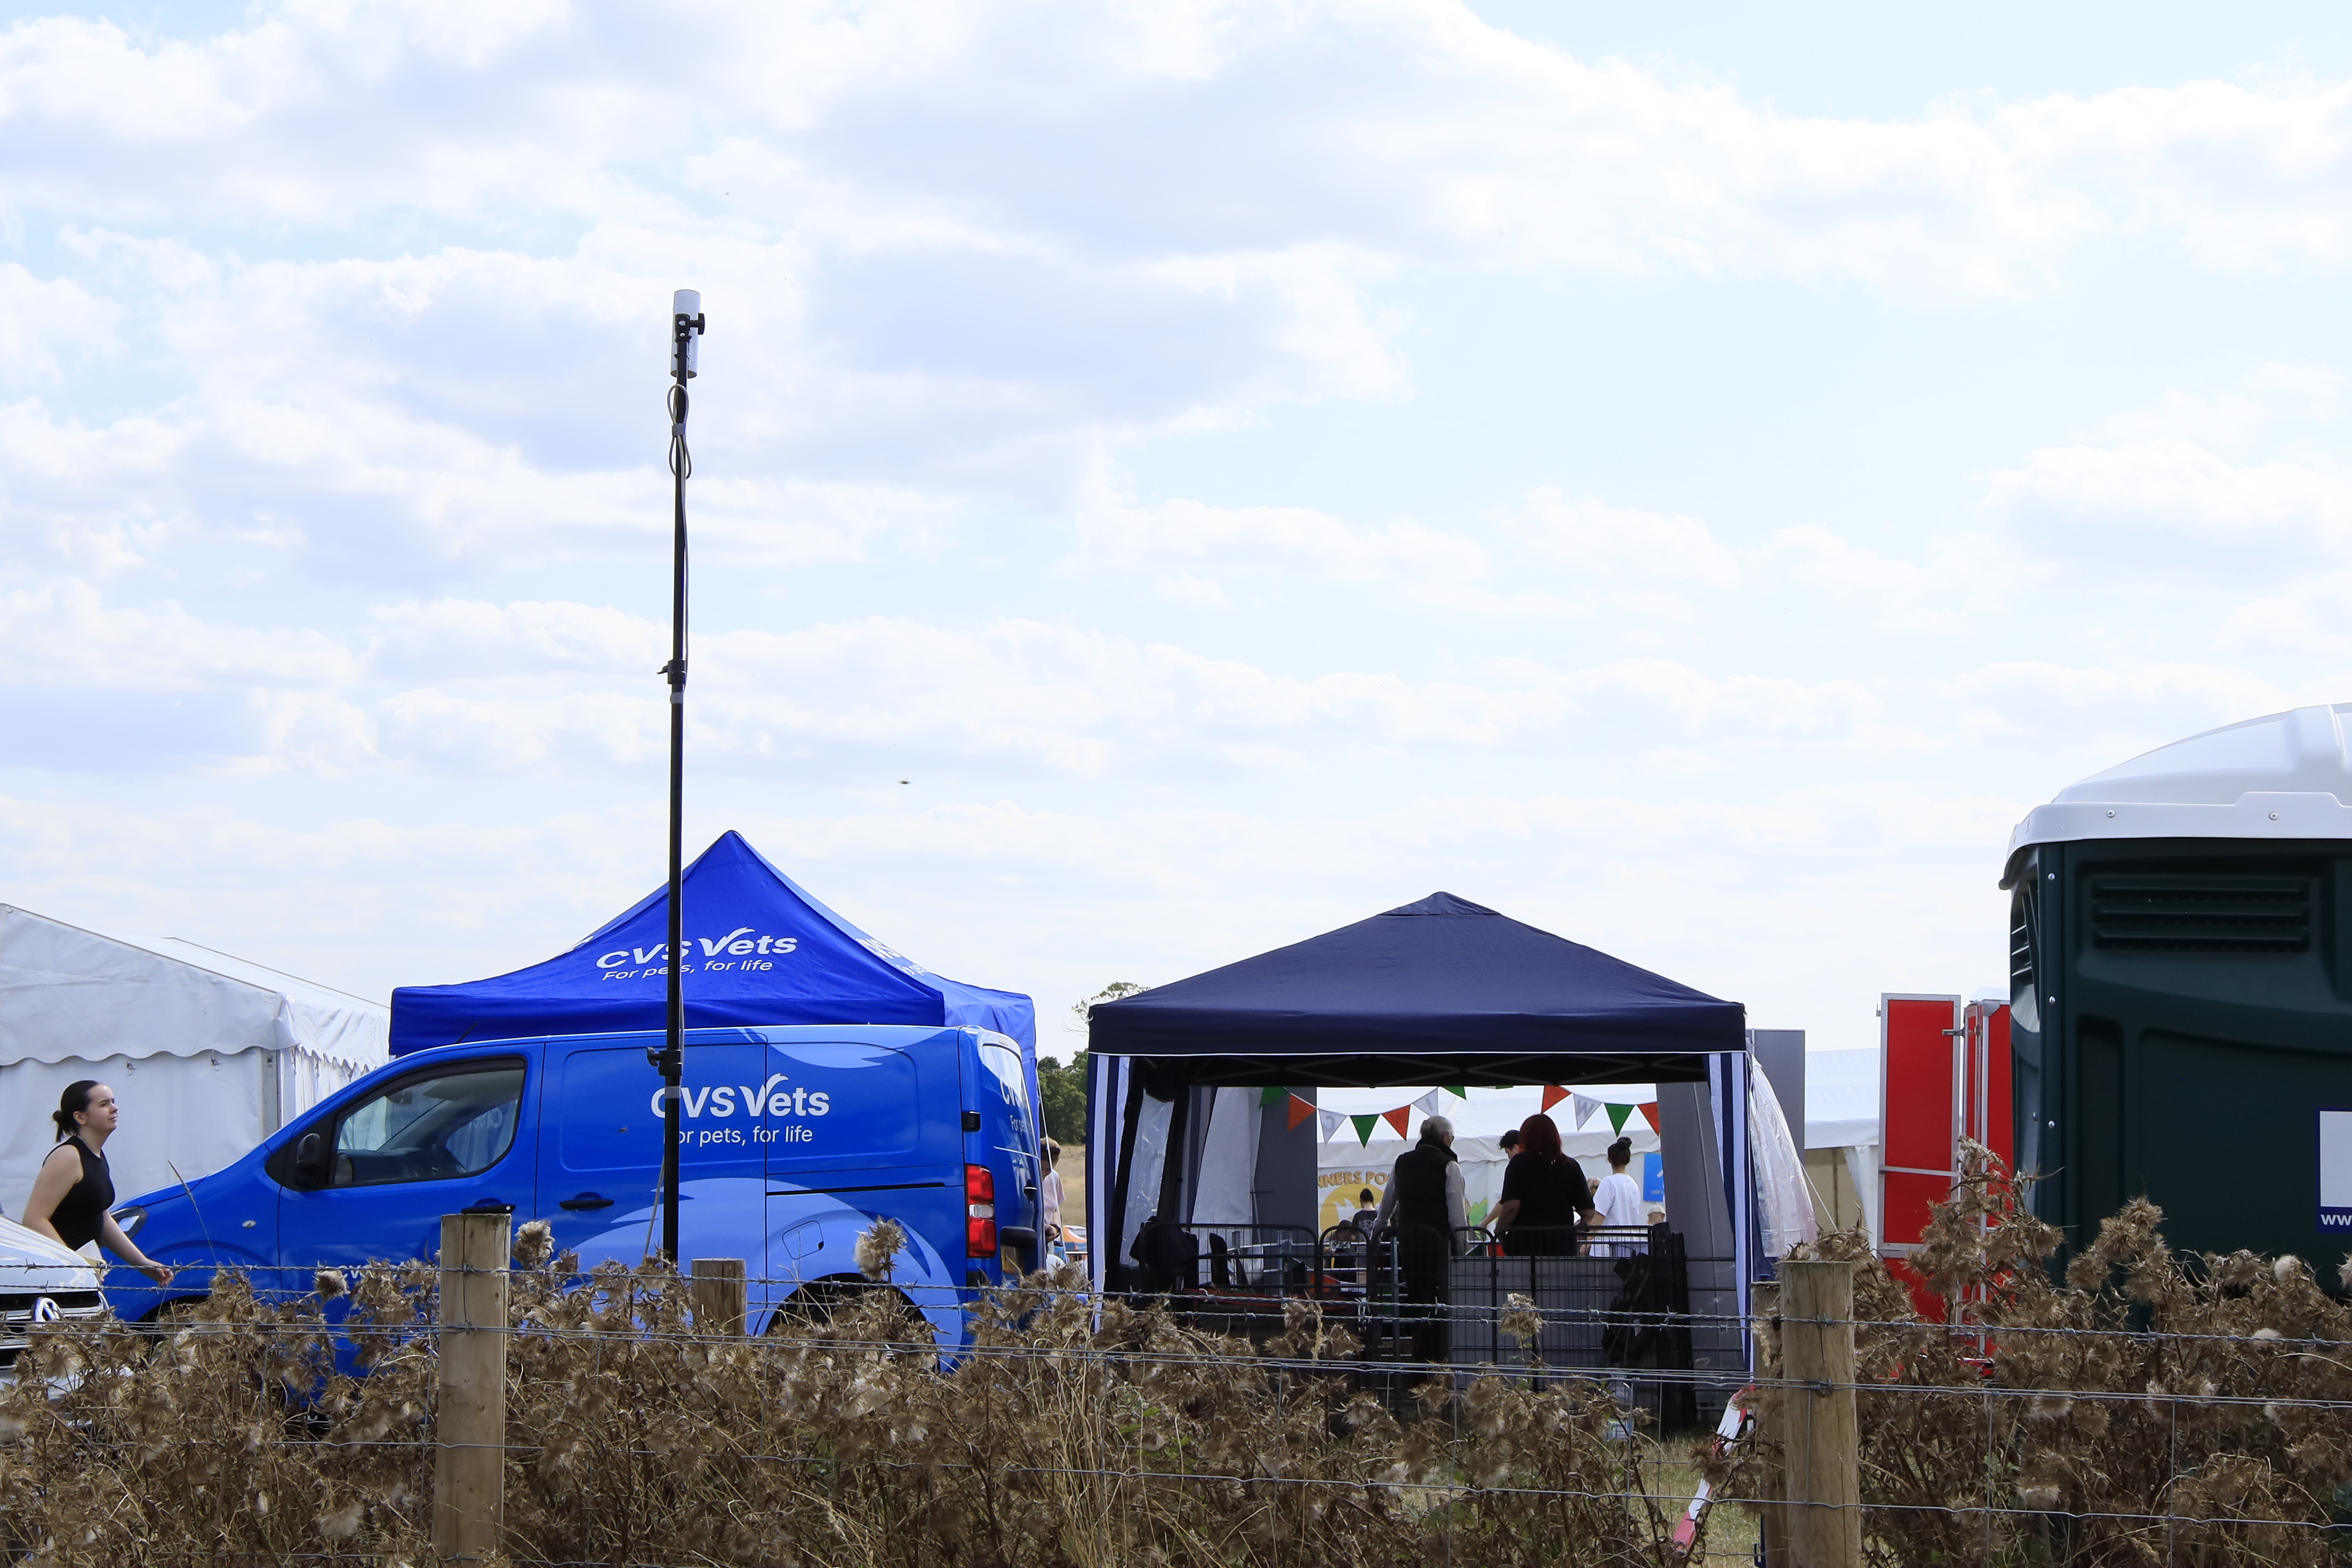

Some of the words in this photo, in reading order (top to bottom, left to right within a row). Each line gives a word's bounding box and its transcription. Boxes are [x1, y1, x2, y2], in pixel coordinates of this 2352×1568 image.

[596, 941, 692, 969] CVS
[698, 927, 798, 956] Vets
[602, 970, 639, 981] For
[642, 964, 695, 978] pes,
[704, 960, 736, 971] for
[740, 960, 773, 971] life
[651, 1086, 734, 1119] CVS
[739, 1073, 830, 1117] Vets
[663, 1130, 694, 1144] or
[700, 1128, 746, 1147] pets,
[752, 1125, 779, 1143] for
[785, 1125, 813, 1142] life
[1365, 1171, 1391, 1185] PO
